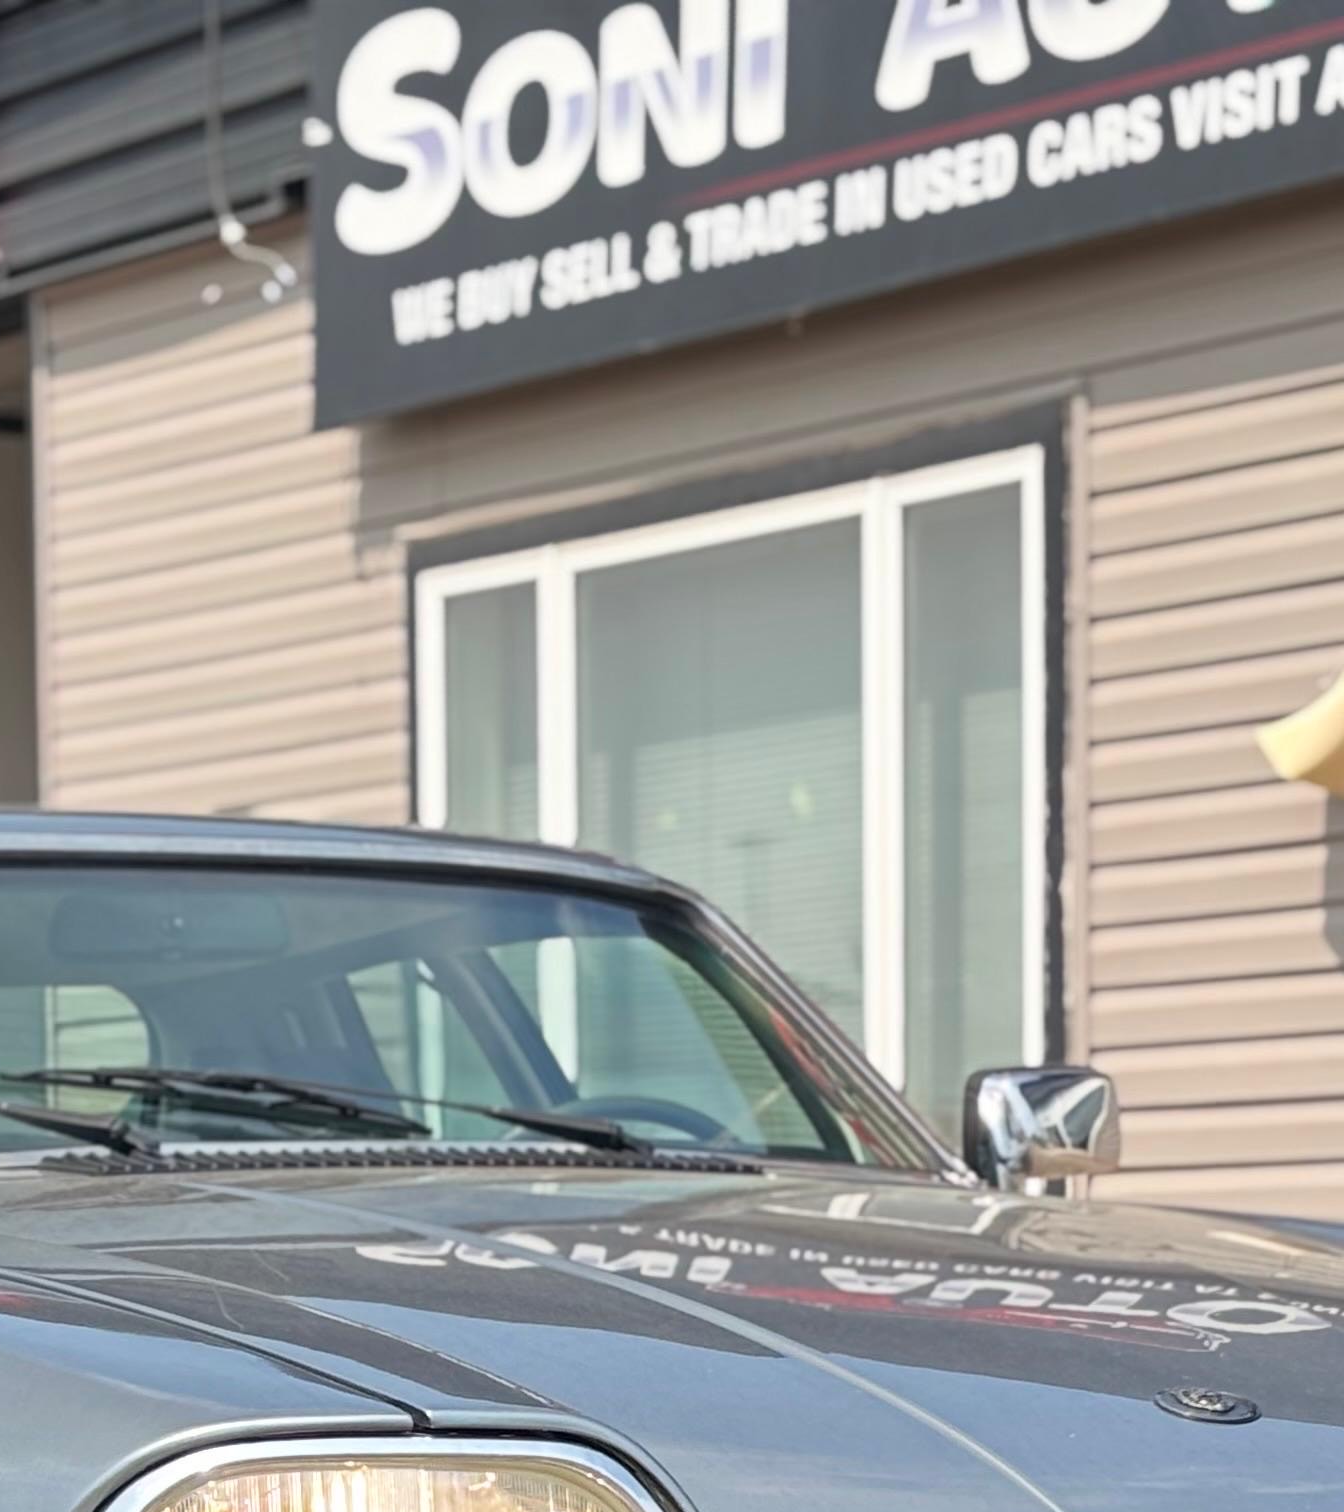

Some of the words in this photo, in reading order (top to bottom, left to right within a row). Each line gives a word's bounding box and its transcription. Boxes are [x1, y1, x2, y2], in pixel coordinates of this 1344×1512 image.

[334, 0, 788, 256] SONI
[391, 277, 455, 346] WE
[456, 255, 539, 331] BUY
[540, 231, 642, 310] SELL
[643, 220, 682, 284] &
[683, 179, 829, 273] TRADE
[834, 164, 887, 236] IN
[892, 132, 1019, 221] USED
[1027, 94, 1164, 188] CARS
[1170, 54, 1311, 151] VISIT
